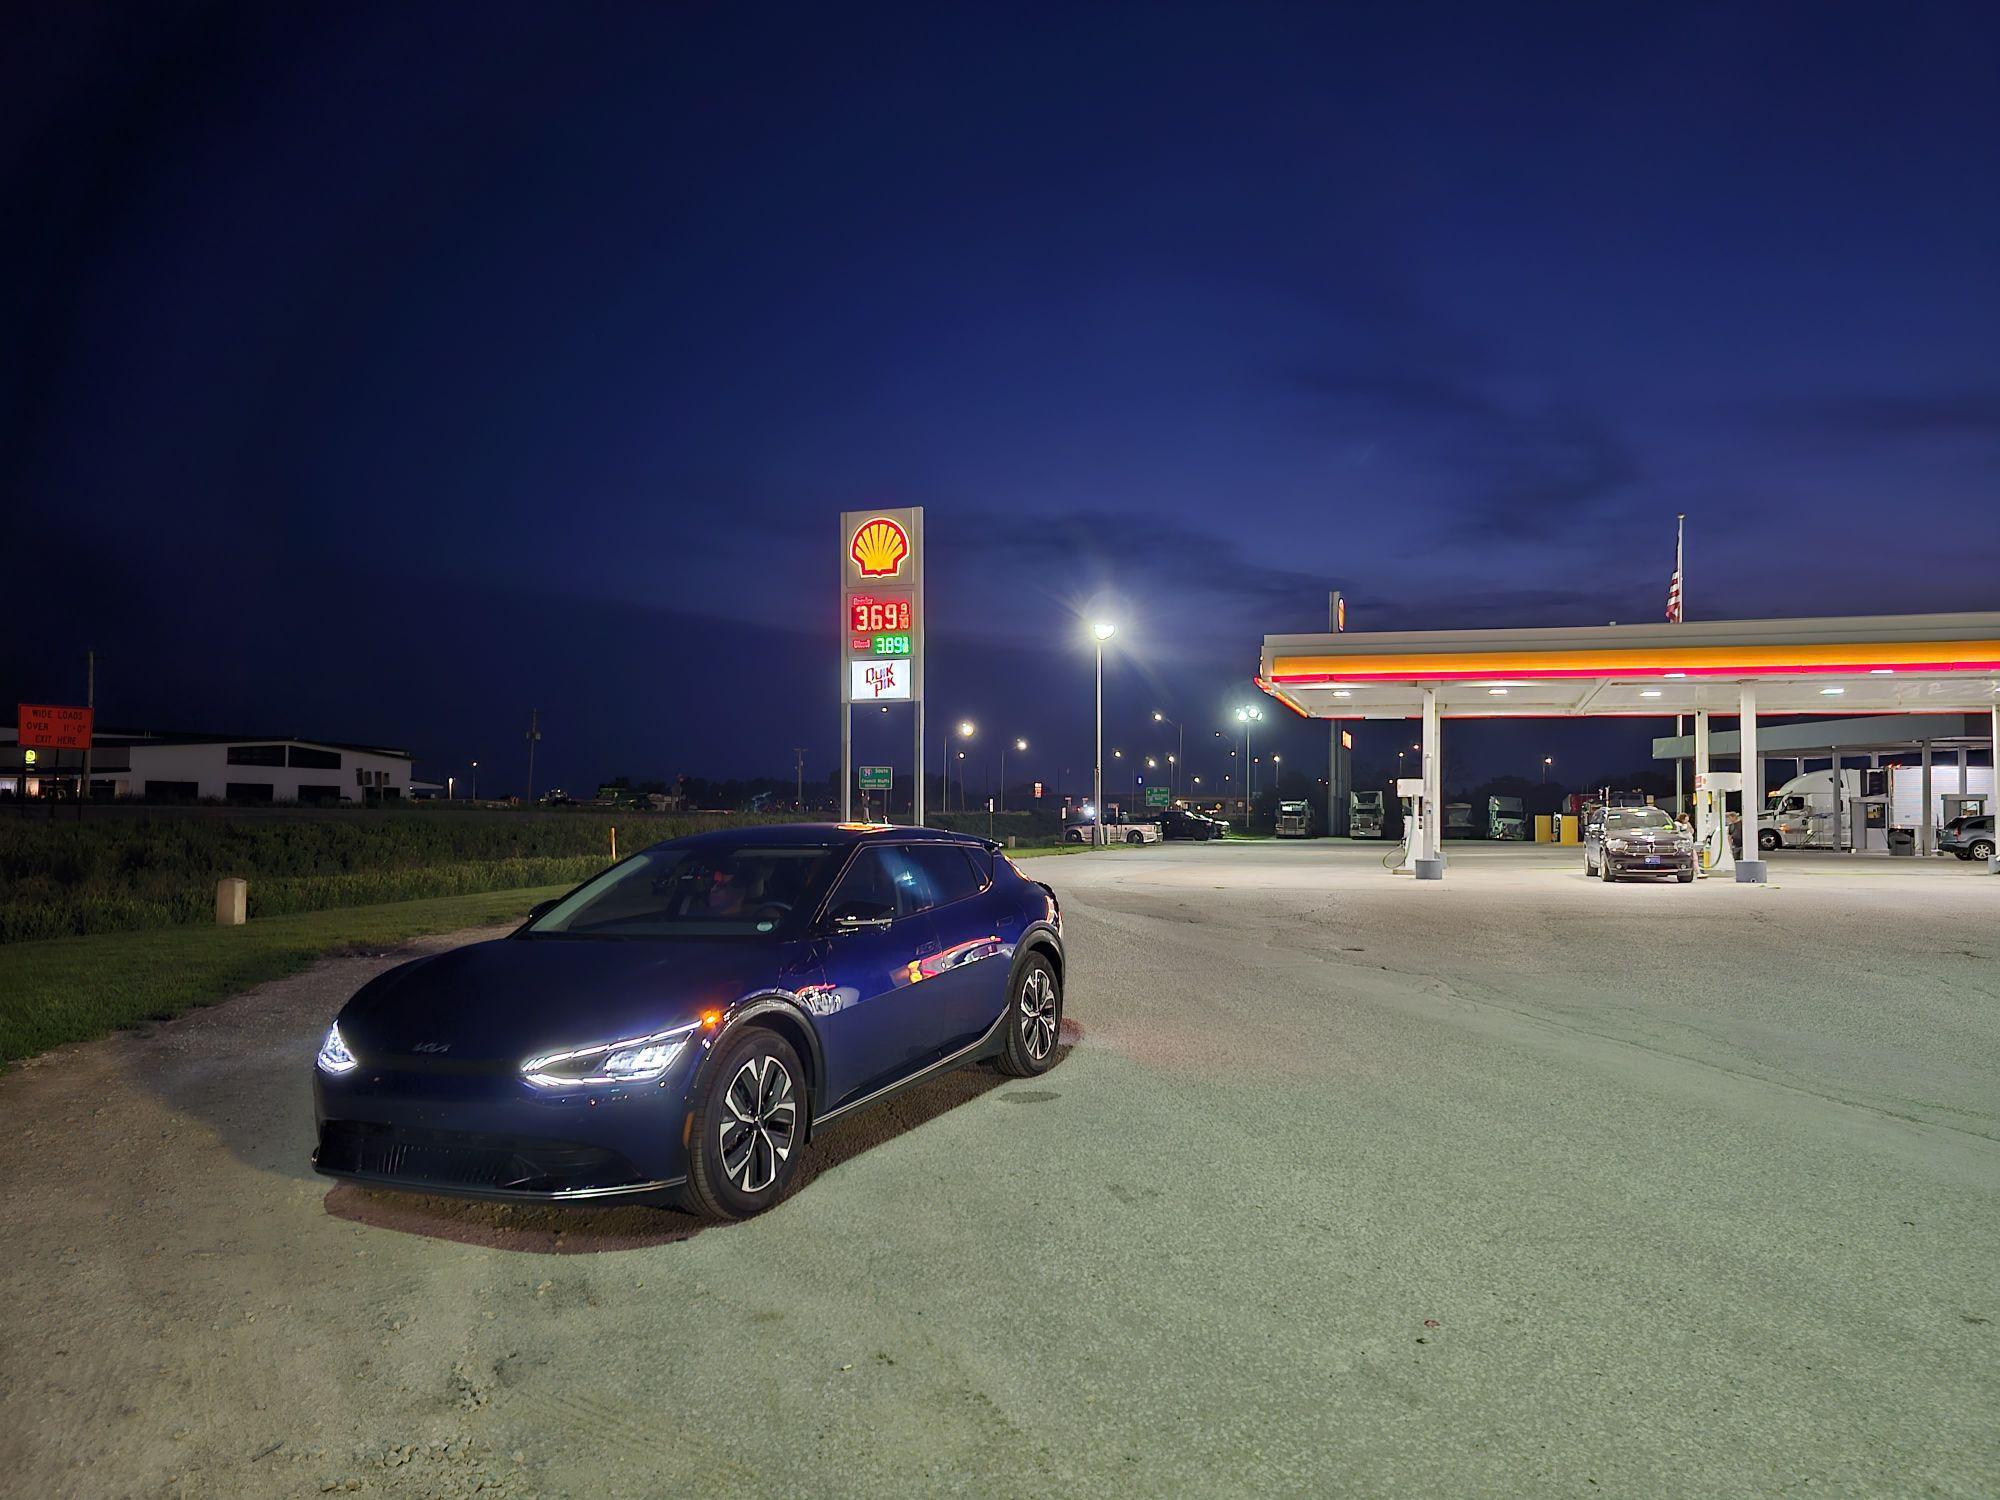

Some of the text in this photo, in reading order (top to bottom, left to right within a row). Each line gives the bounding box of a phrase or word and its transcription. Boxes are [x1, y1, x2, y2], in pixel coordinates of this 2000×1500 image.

[32, 710, 84, 721] WIDE LOADS
[26, 722, 49, 731] OVER
[35, 735, 77, 745] EXIT HERE
